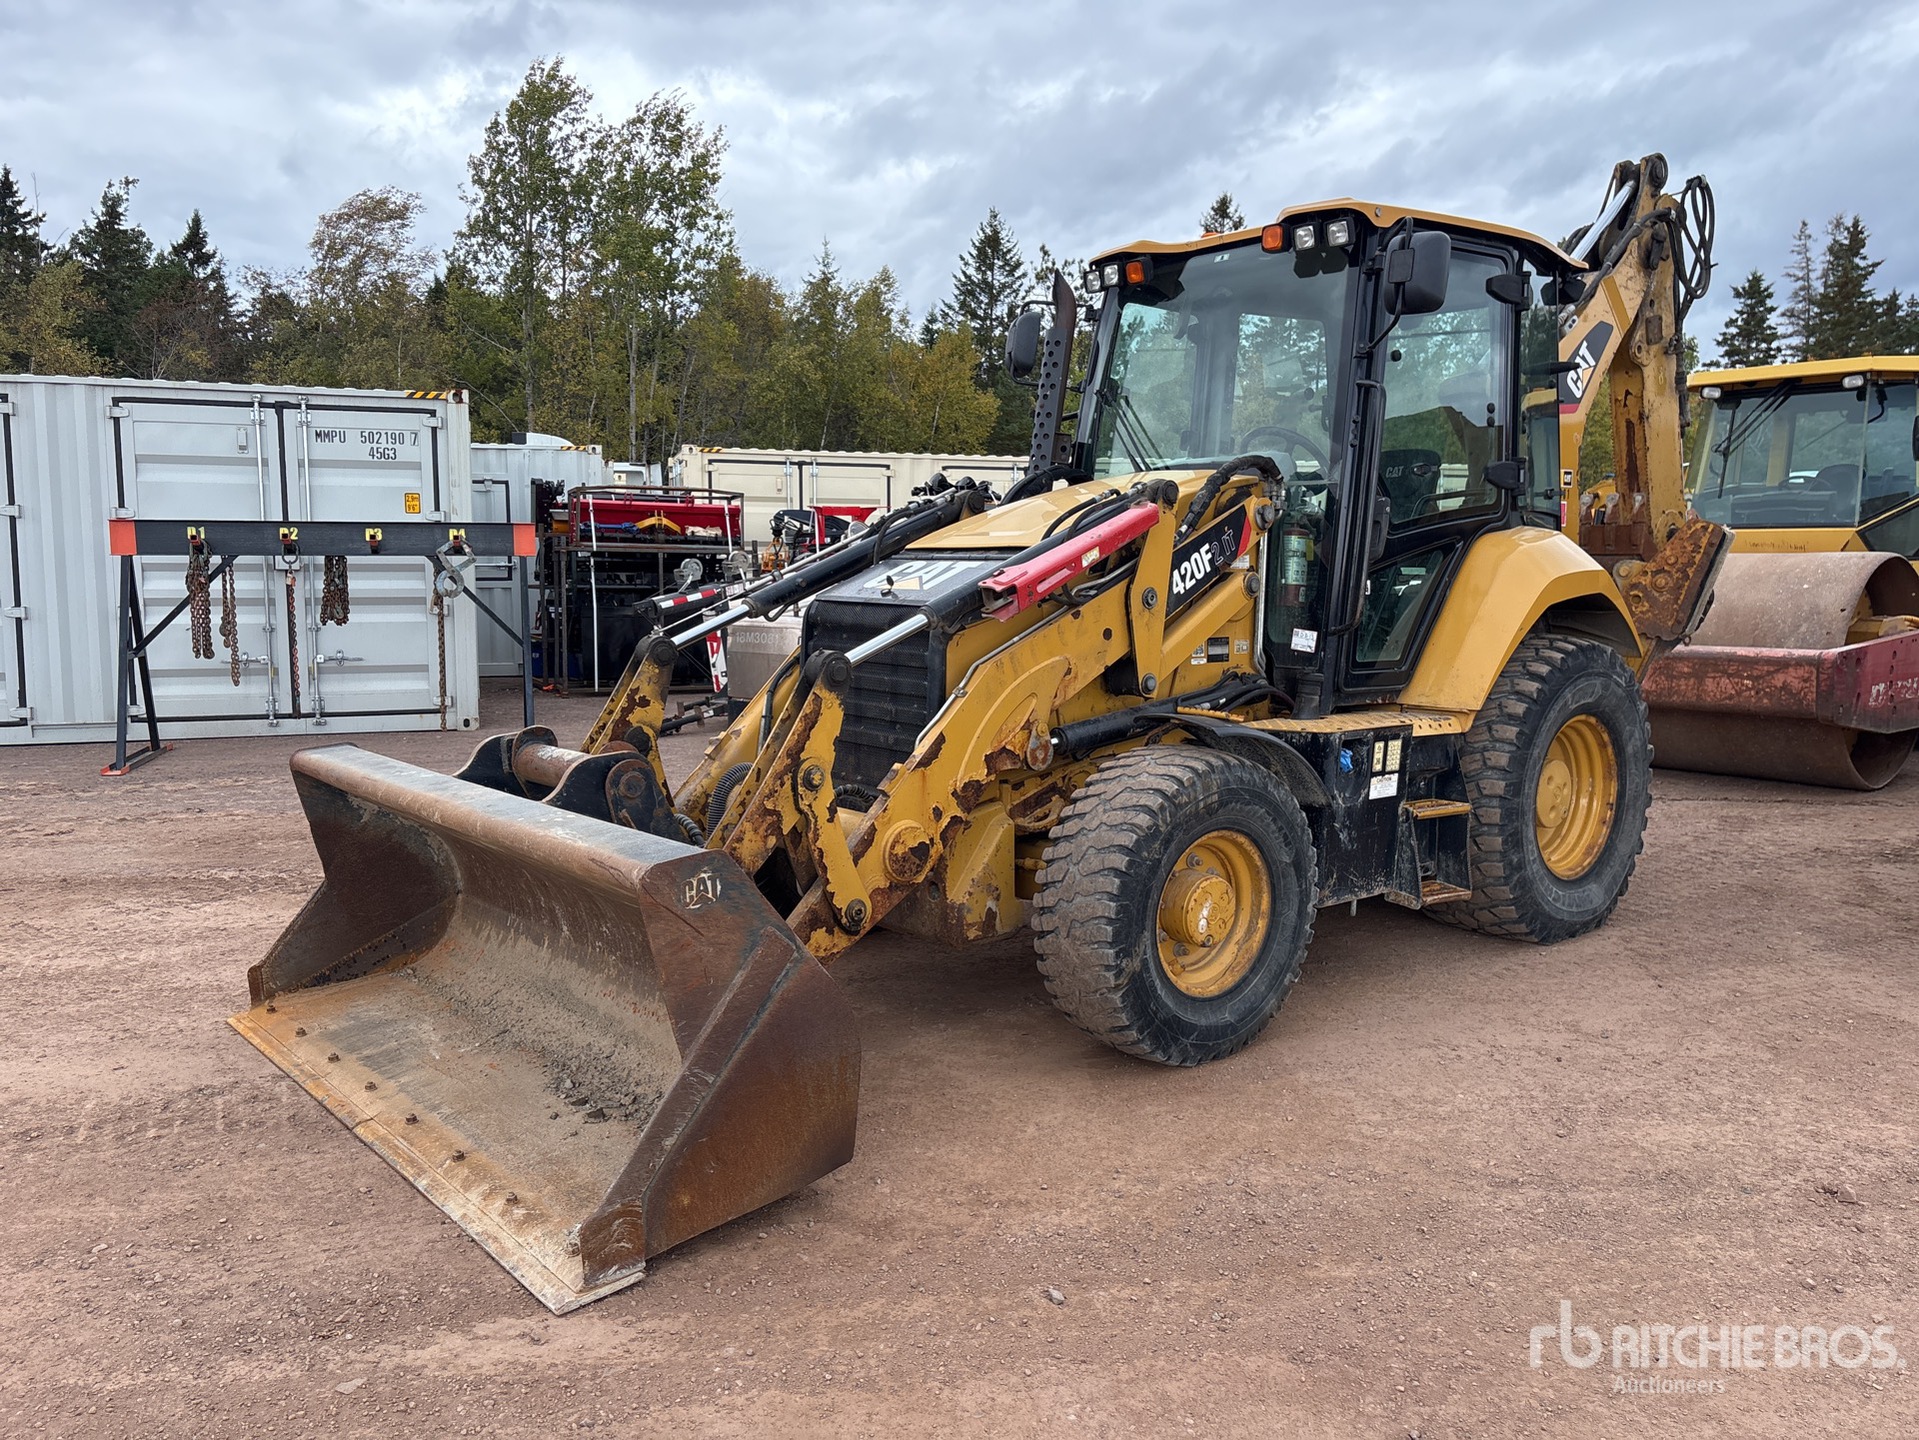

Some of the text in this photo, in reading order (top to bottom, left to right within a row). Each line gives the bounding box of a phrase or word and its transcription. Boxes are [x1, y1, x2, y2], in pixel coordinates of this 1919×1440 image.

[1567, 340, 1596, 398] CAT
[315, 430, 419, 446] MMPU 502190 7
[368, 446, 397, 460] 45G3
[1386, 466, 1404, 478] CAT
[863, 561, 985, 591] CAT
